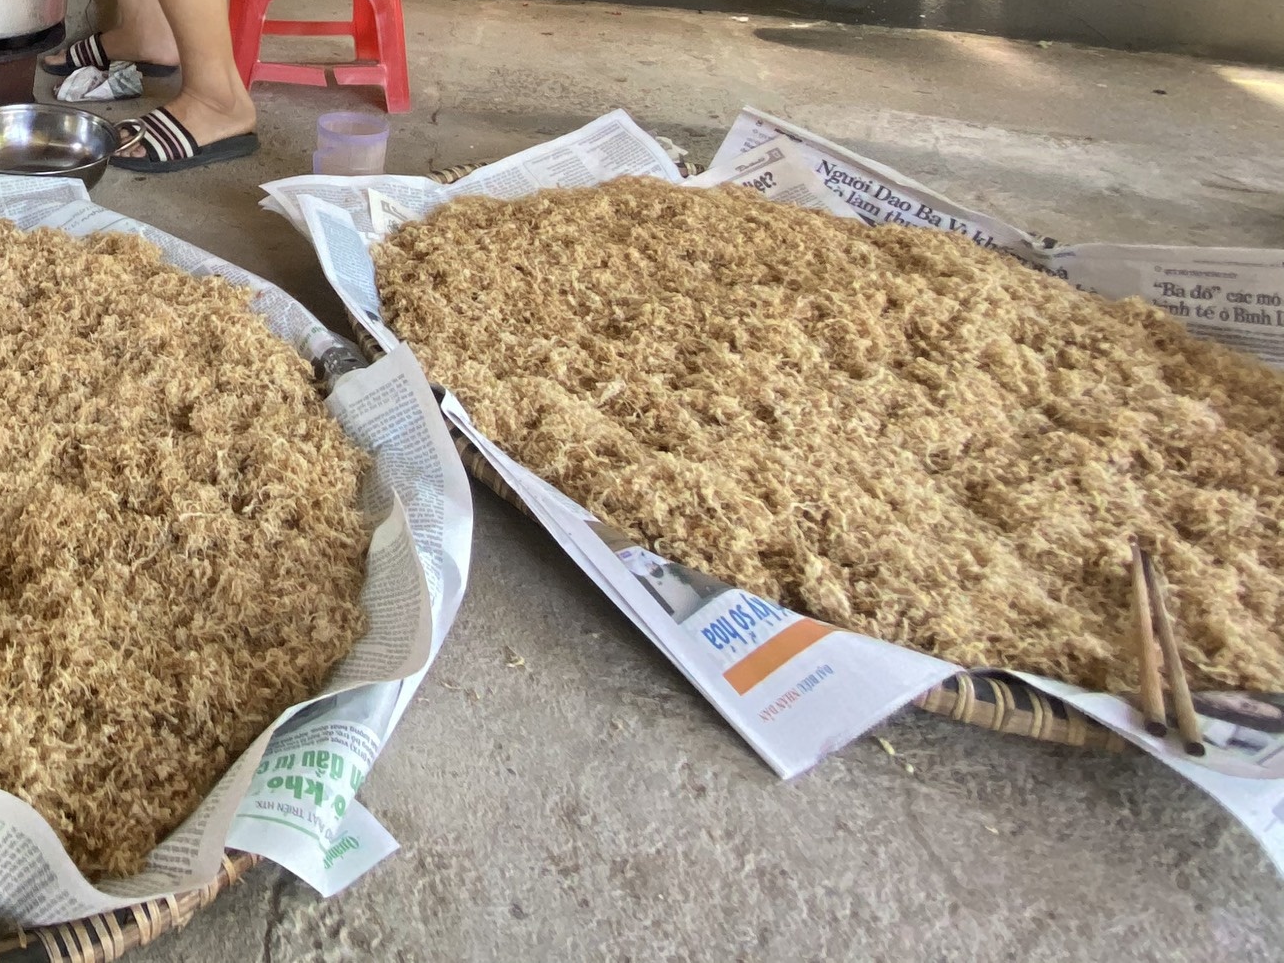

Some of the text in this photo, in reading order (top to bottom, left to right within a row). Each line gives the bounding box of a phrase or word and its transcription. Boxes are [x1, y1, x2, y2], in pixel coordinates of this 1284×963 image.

[816, 159, 873, 192] Người
[874, 185, 912, 212] Dao
[914, 204, 942, 227] Ba
[701, 616, 748, 653] hóa
[301, 749, 344, 780] đầu
